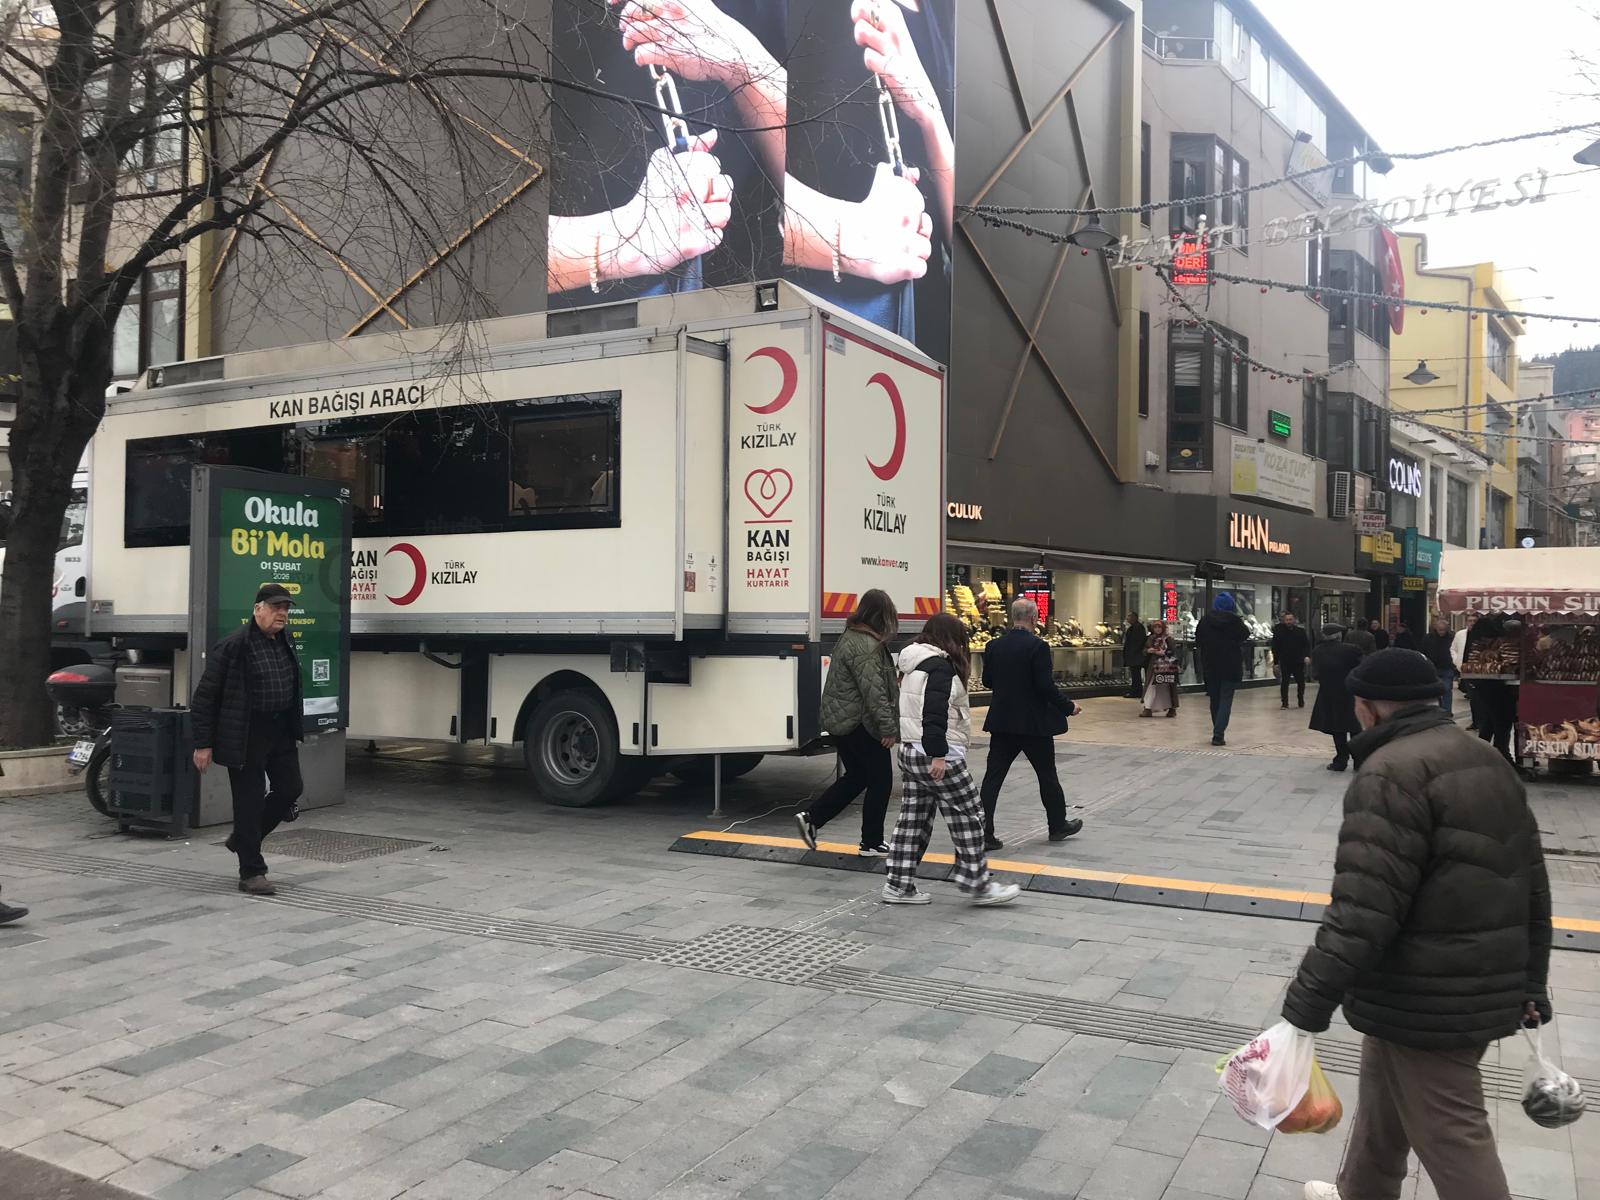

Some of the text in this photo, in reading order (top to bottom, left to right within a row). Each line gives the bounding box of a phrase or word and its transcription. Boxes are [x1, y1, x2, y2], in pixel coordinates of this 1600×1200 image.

[269, 385, 425, 419] KAN BAĞIŞI ARACI
[757, 423, 781, 432] TÜRK
[741, 432, 797, 449] KIZILAY
[1389, 457, 1422, 498] COLIN'S
[877, 491, 896, 508] TÜRK
[244, 496, 319, 528] Okula
[864, 507, 907, 535] KIZILAY
[747, 529, 790, 548] KAN
[747, 549, 790, 564] BAĞIŞI
[861, 555, 909, 571] www.kanver.org
[260, 561, 301, 573] 01 ŞUBAT
[444, 560, 465, 569] TÜRK
[351, 568, 378, 582] AĞIŞI
[431, 570, 478, 585] KIZILAY
[747, 568, 790, 578] HAYAT
[352, 582, 377, 592] AYAT
[351, 593, 377, 601] RTARIR
[1466, 593, 1550, 613] PİŞKİN
